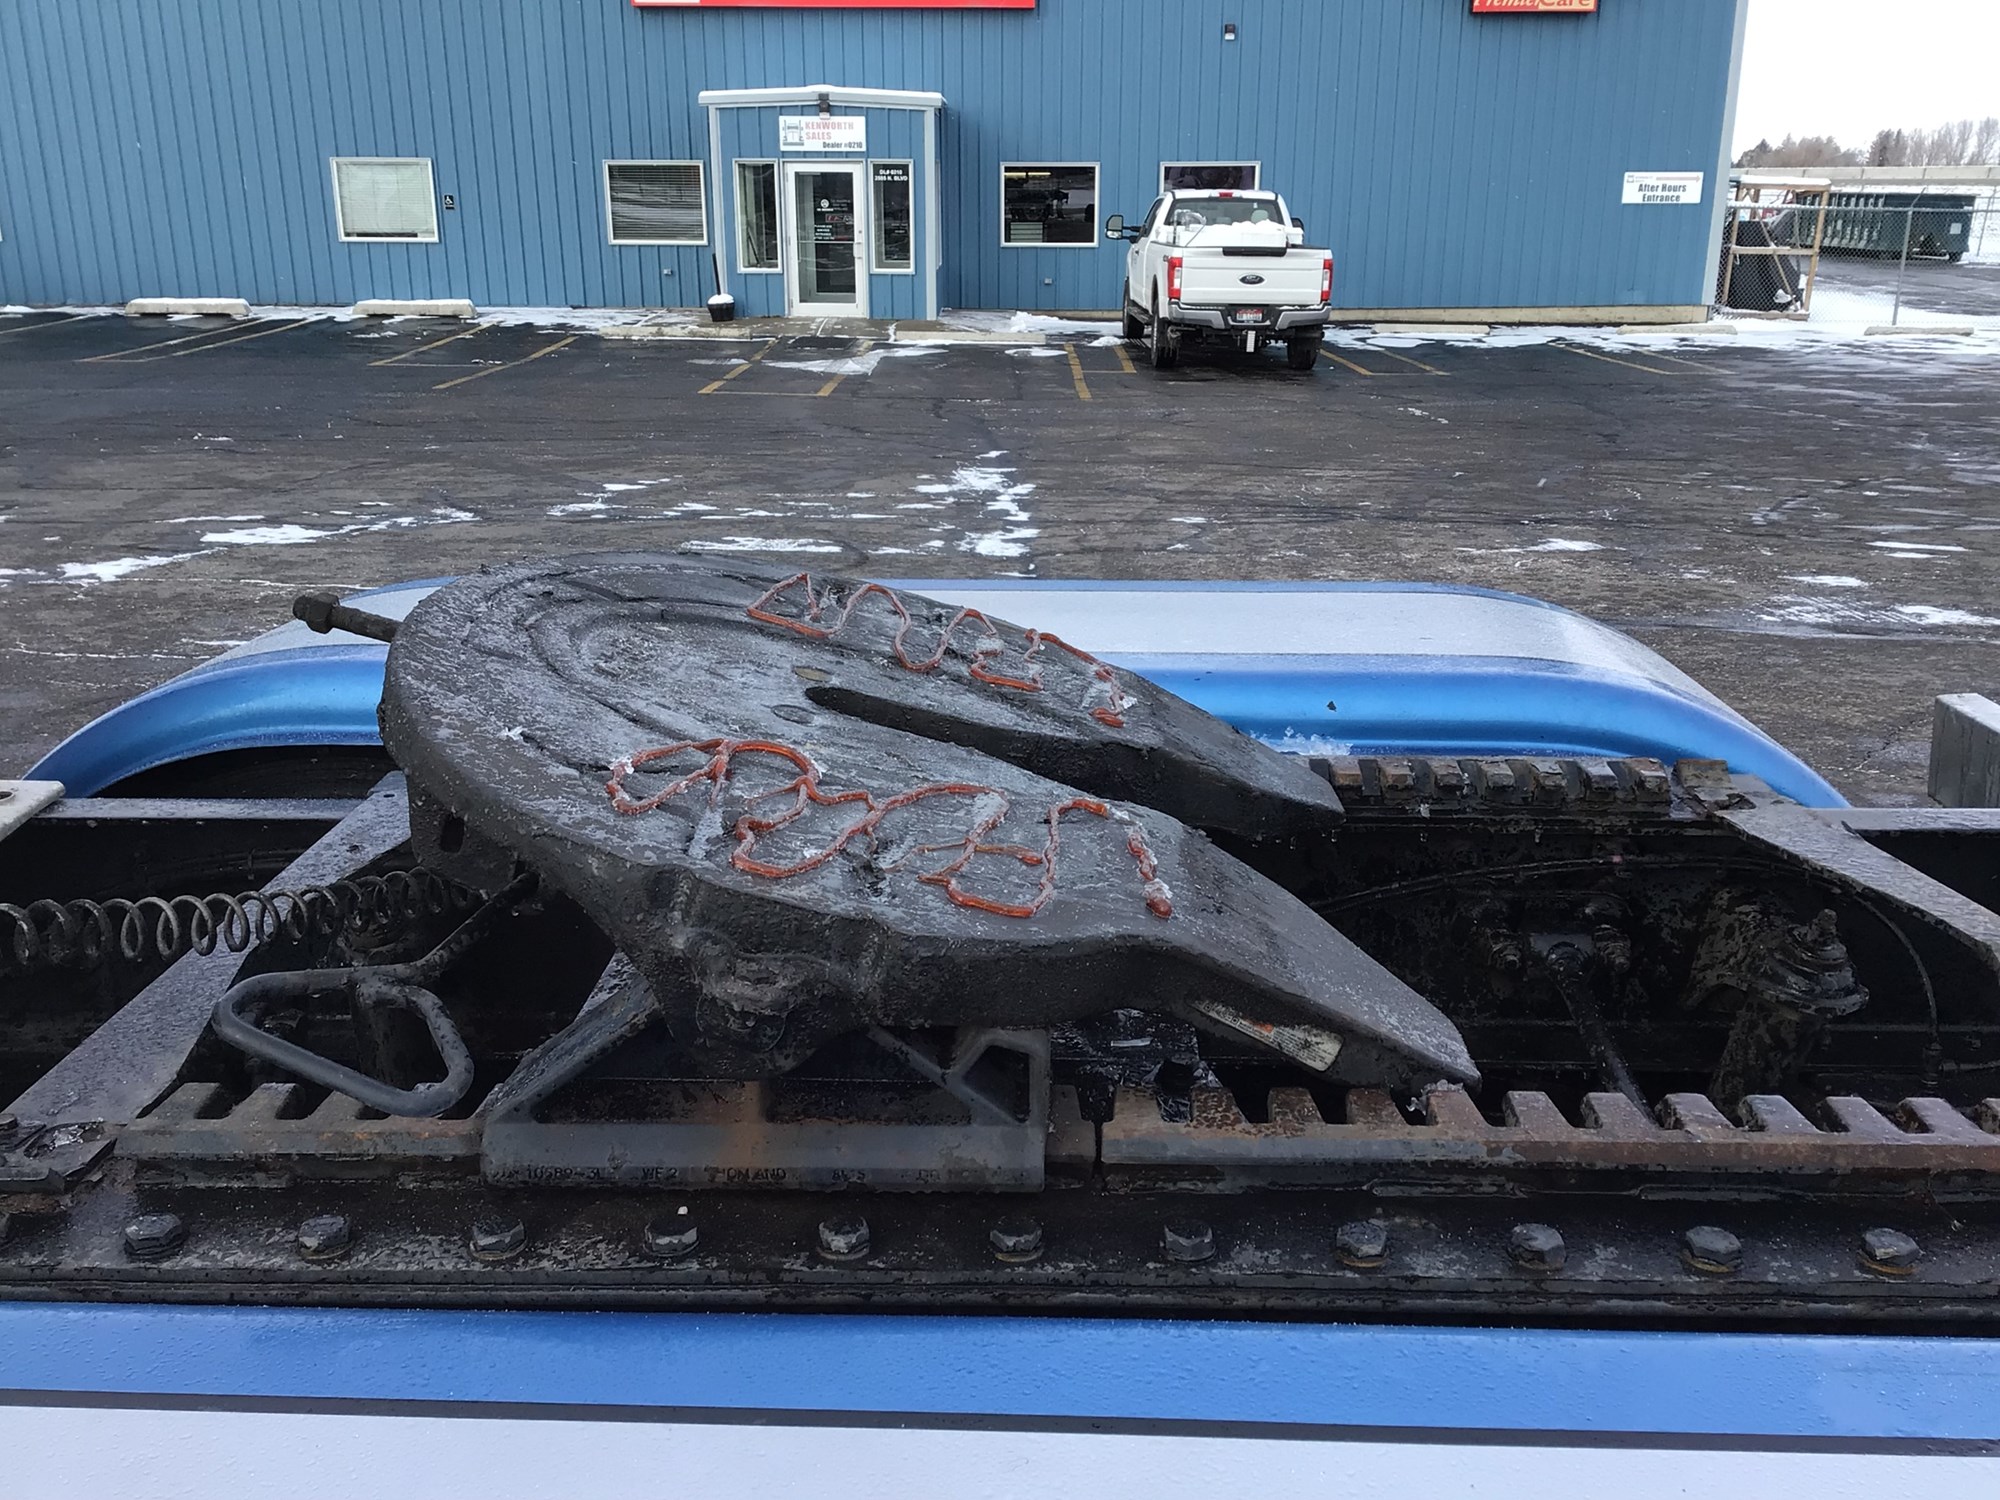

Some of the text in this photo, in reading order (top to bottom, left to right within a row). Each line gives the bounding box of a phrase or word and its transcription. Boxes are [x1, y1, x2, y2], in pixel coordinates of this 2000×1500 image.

[805, 121, 854, 130] KENWORTH
[805, 131, 832, 140] SALES
[822, 141, 842, 149] Dealer
[1637, 183, 1687, 193] After Hours
[1642, 193, 1681, 202] Entrance
